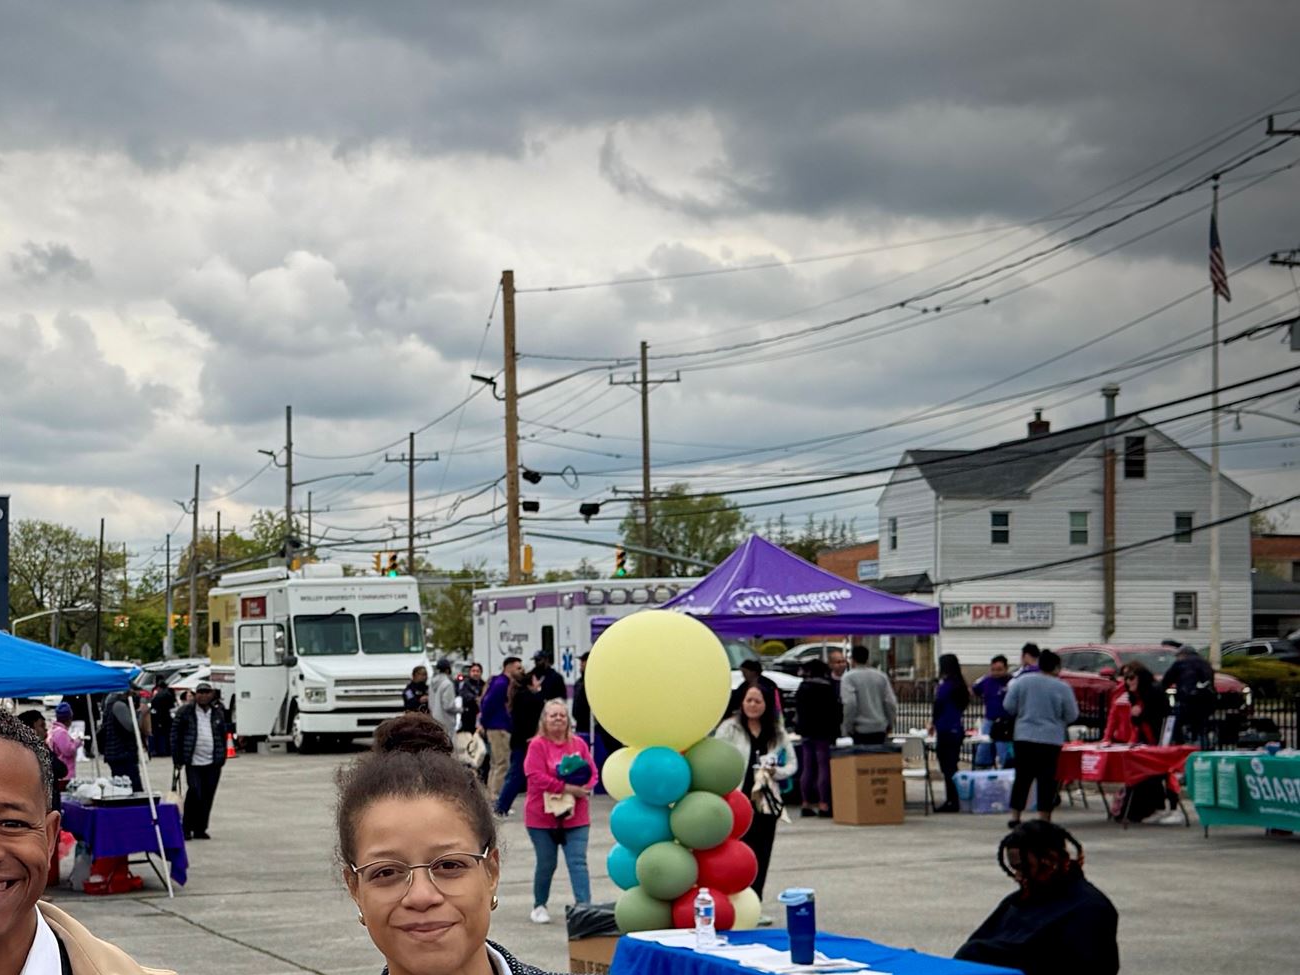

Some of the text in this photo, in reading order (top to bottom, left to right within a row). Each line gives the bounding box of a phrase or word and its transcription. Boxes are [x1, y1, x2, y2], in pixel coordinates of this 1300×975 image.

[736, 588, 852, 608] NYU Langone
[773, 600, 837, 614] Health
[971, 605, 1011, 619] DELI
